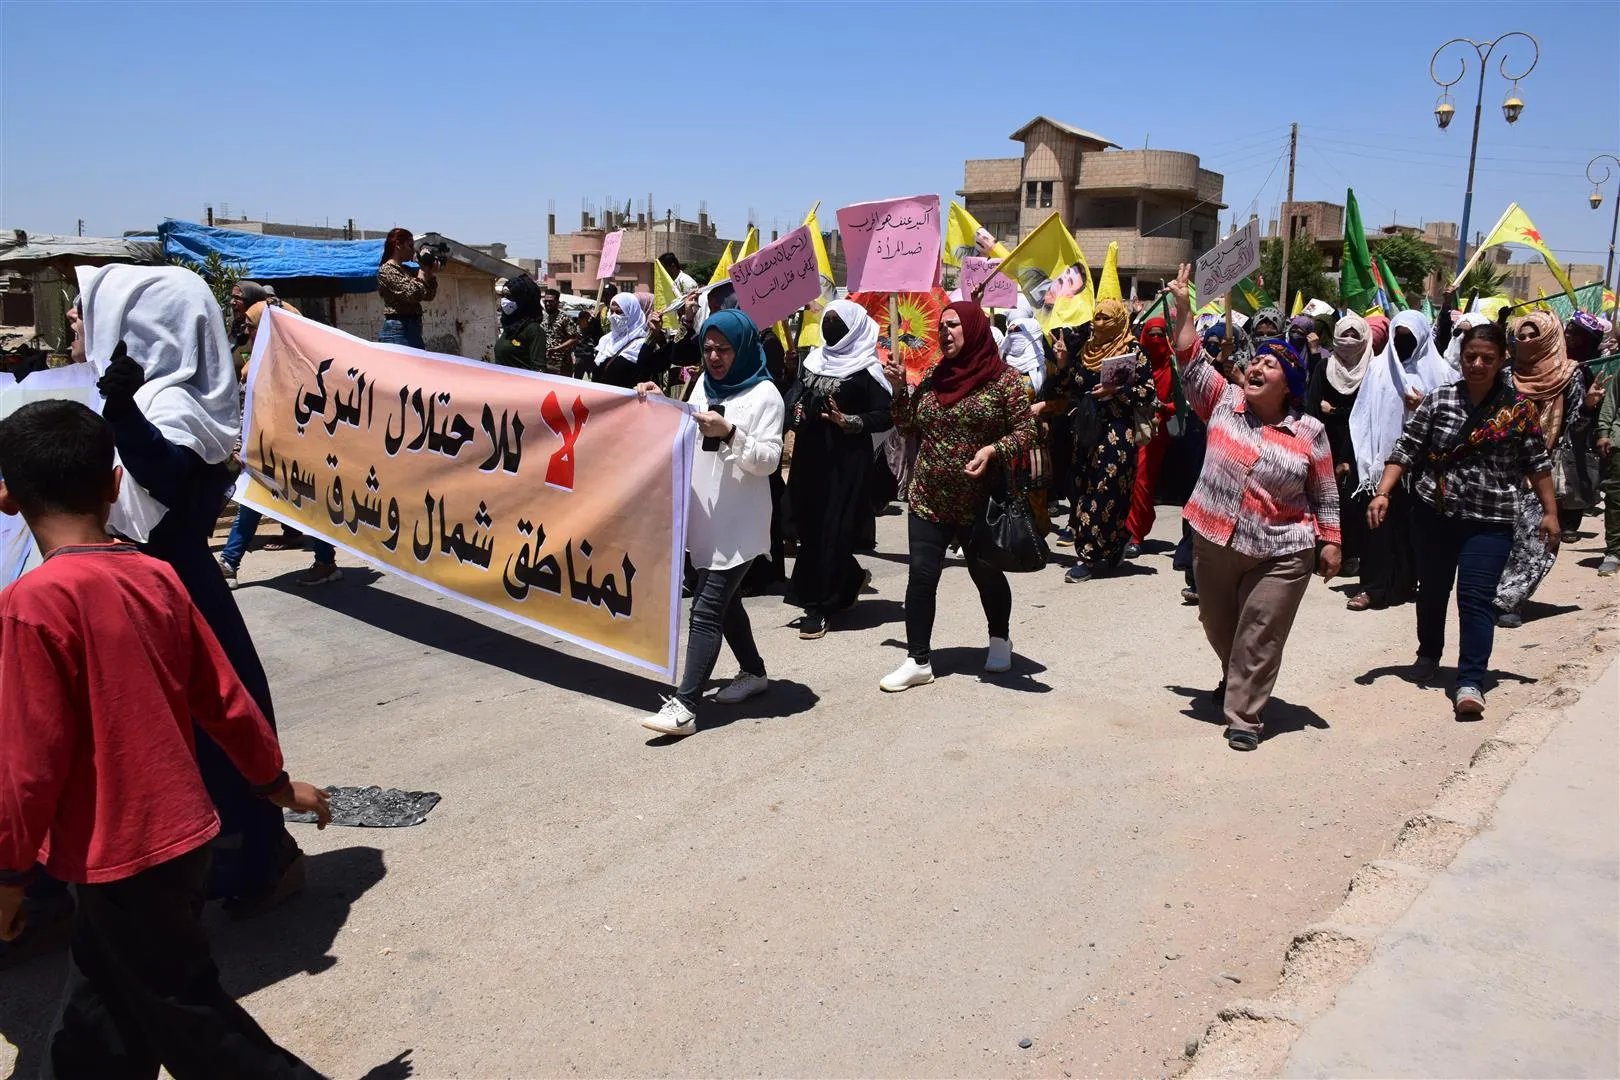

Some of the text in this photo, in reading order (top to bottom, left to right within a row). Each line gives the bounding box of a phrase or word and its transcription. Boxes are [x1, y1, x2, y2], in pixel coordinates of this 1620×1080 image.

[876, 213, 892, 231] هو
[776, 244, 801, 261] حياة
[799, 233, 808, 252] لا
[877, 237, 922, 259] ضد المرأة
[751, 257, 777, 276] بدون
[752, 251, 815, 305] يكفي قتل النساء
[294, 358, 589, 491] لا للاحتلال التركي
[259, 429, 636, 618] لمناطق شمال وشرق سوريا
